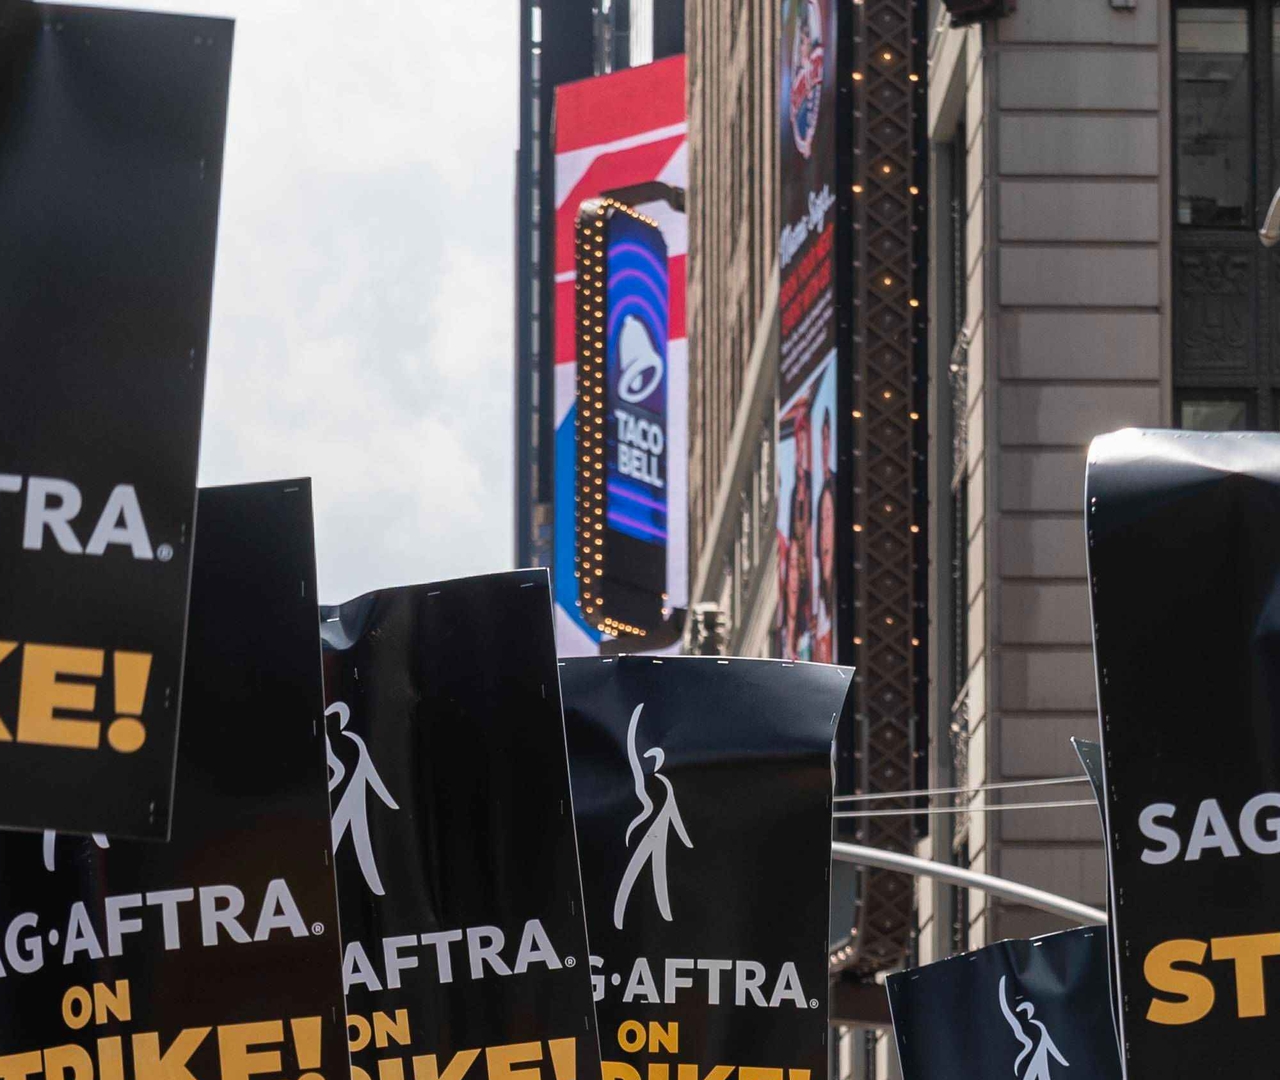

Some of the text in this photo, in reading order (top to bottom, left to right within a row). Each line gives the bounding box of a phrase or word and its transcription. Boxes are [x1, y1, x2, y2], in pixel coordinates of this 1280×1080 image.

[614, 408, 663, 455] TACO
[618, 443, 663, 488] BELL
[60, 979, 132, 1030] ON
[347, 1009, 411, 1053] ON
[617, 1020, 679, 1054] ON
